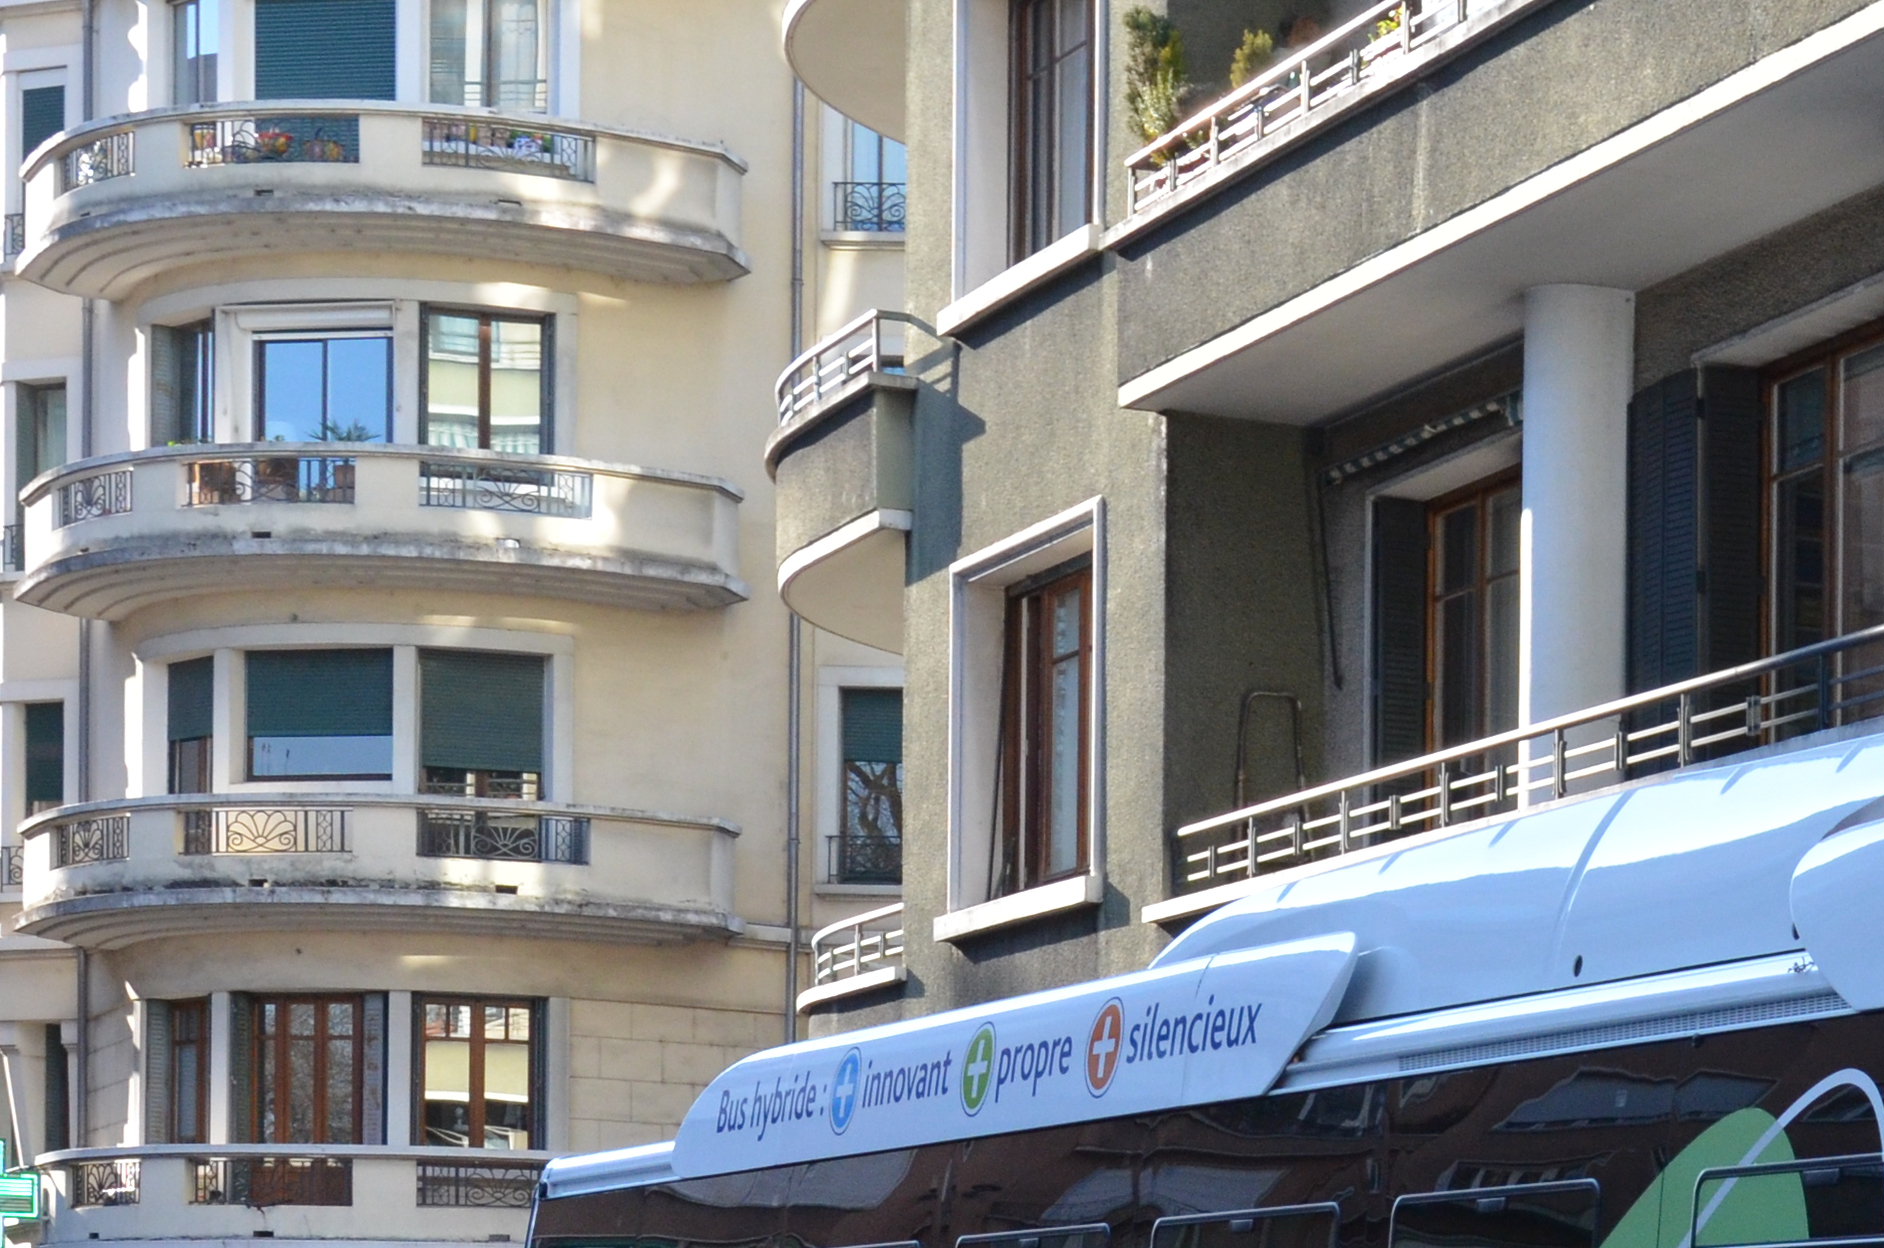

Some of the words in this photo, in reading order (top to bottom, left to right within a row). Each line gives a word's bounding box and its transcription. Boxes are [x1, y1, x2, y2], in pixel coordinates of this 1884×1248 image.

[716, 1088, 748, 1134] Bus
[750, 1069, 818, 1142] hybride
[861, 1048, 952, 1110] innovant
[996, 1032, 1073, 1104] propre
[1125, 993, 1263, 1064] silencieux
